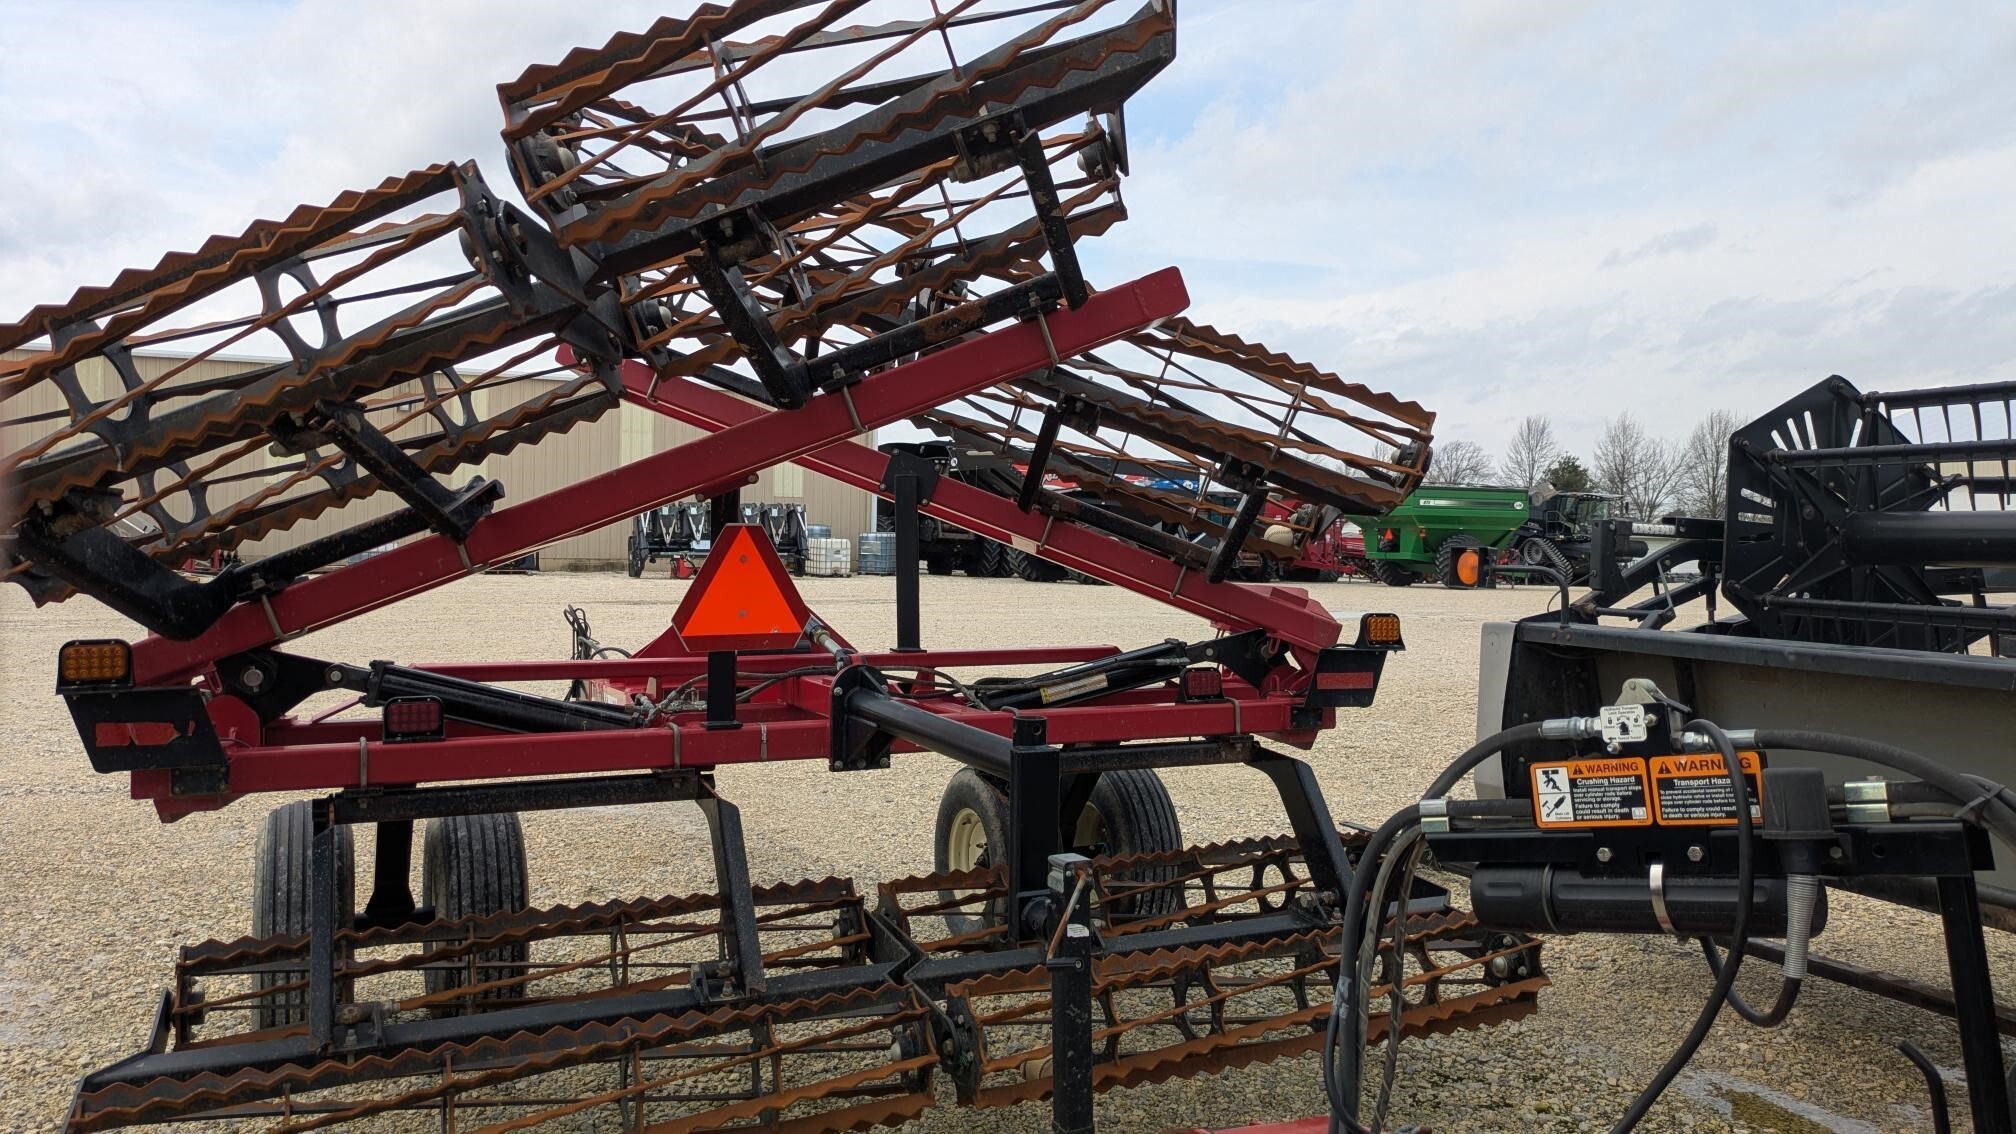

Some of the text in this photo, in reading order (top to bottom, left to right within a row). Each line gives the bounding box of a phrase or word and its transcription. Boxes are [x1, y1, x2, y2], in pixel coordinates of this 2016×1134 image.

[1585, 762, 1638, 774] WARNING
[1674, 757, 1751, 771] WARNG
[1673, 779, 1709, 787] Transport
